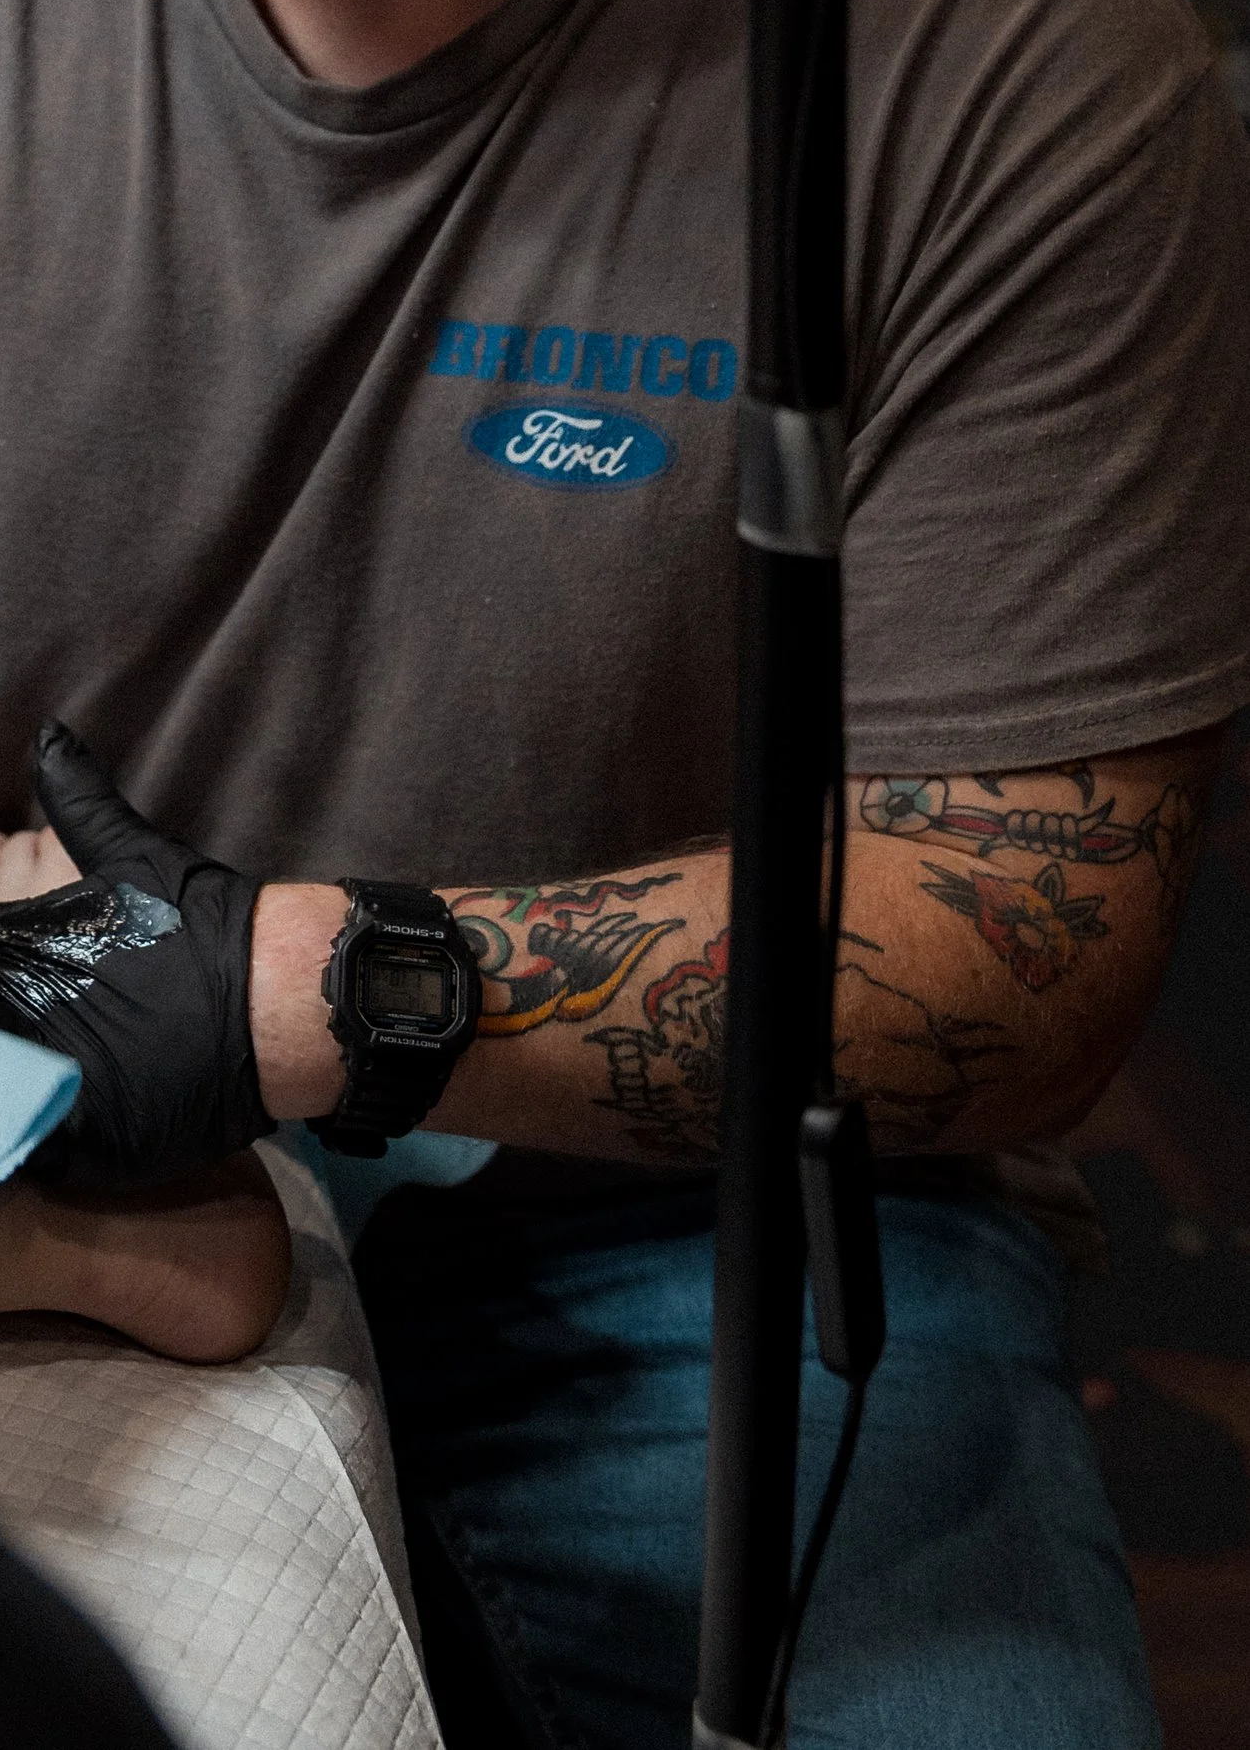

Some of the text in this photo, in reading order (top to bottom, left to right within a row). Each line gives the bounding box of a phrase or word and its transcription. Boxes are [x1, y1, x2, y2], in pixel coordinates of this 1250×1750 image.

[428, 319, 738, 402] BRONCO
[505, 408, 634, 478] Ford
[383, 923, 445, 939] G-SHOCK
[379, 1034, 441, 1049] PROTECTION
